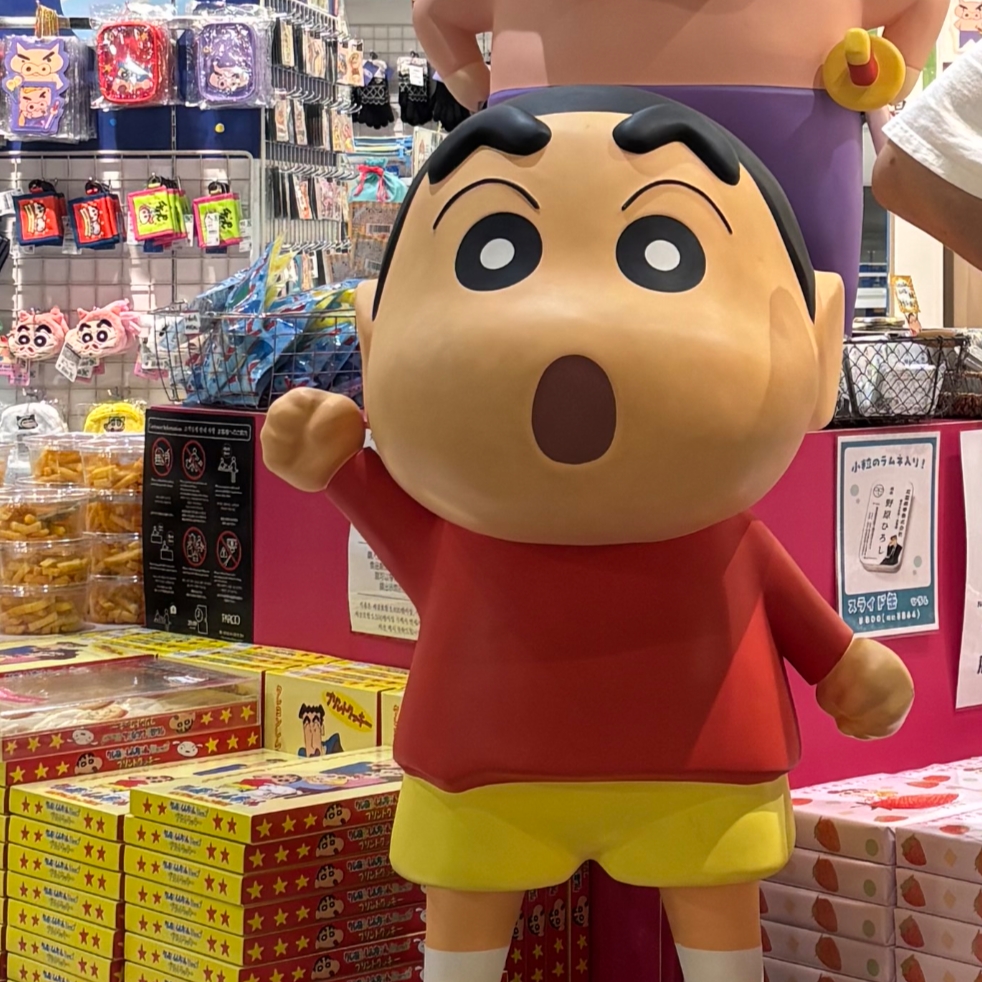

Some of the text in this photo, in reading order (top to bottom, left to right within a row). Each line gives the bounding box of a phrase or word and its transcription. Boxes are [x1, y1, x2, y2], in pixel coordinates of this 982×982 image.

[877, 499, 894, 555] 野原ひろし
[848, 592, 898, 615] スライド缶
